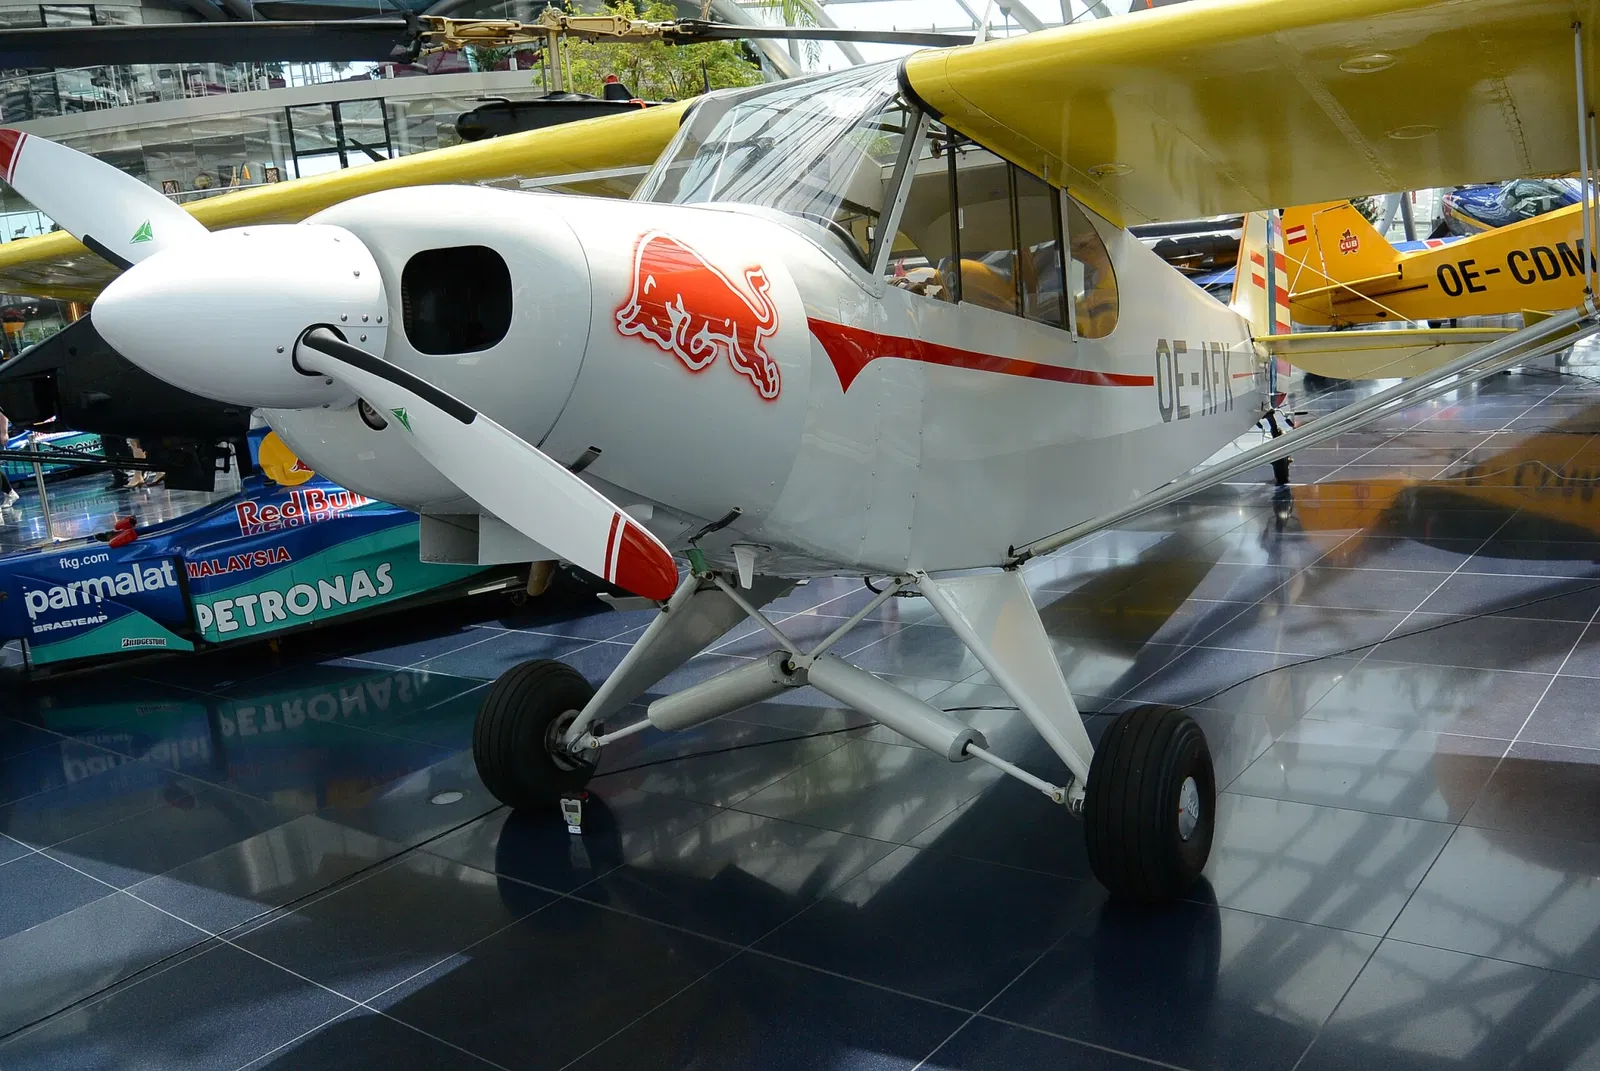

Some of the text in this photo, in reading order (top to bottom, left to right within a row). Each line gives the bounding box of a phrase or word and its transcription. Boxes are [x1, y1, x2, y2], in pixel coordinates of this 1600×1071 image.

[1340, 240, 1358, 250] CUB
[1156, 338, 1233, 423] OE-AFK
[236, 490, 304, 528] Red
[59, 552, 110, 570] fkg.com
[186, 546, 292, 579] MALAYSIA
[24, 560, 178, 620] parmalat
[195, 562, 394, 635] PETRONAS
[33, 614, 108, 633] BRASTEMP
[122, 637, 167, 648] BRIDGESTONE
